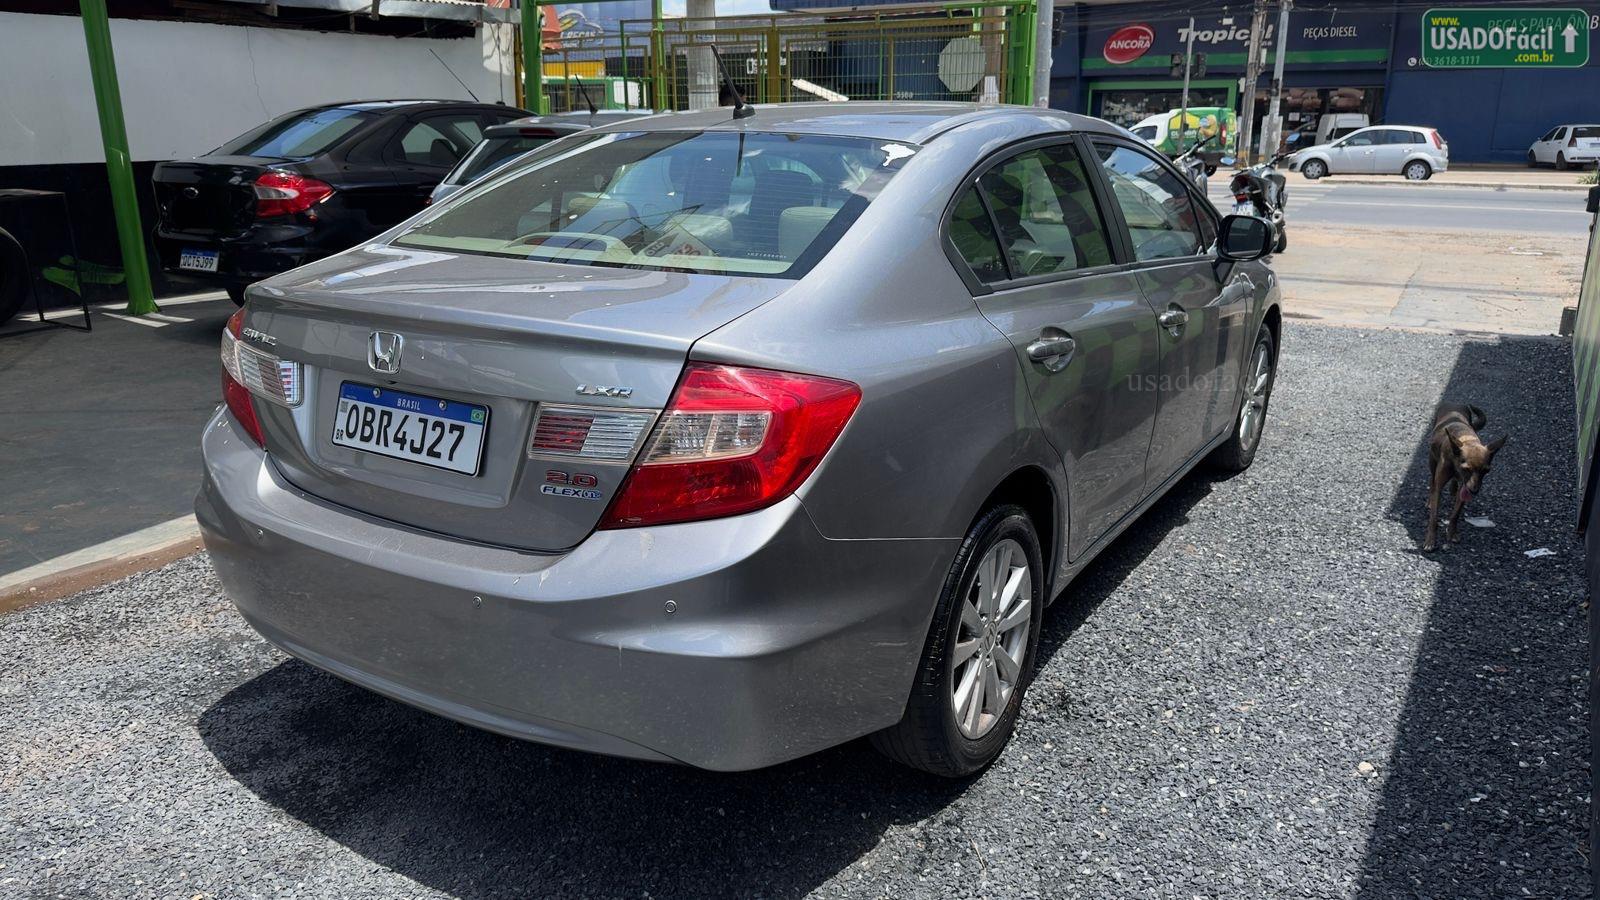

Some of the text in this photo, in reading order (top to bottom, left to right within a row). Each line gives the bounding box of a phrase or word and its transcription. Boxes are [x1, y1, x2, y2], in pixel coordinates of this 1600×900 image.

[1303, 26, 1358, 40] PEÇAS DIESEL
[1109, 39, 1151, 49] ANCORA
[1434, 55, 1481, 66] 3618-1111
[576, 384, 633, 398] LXR
[397, 398, 420, 410] BRASIL
[335, 429, 344, 440] BR
[345, 404, 465, 462] OBR4J27
[546, 470, 598, 488] 2.0
[543, 486, 580, 497] FLEX
